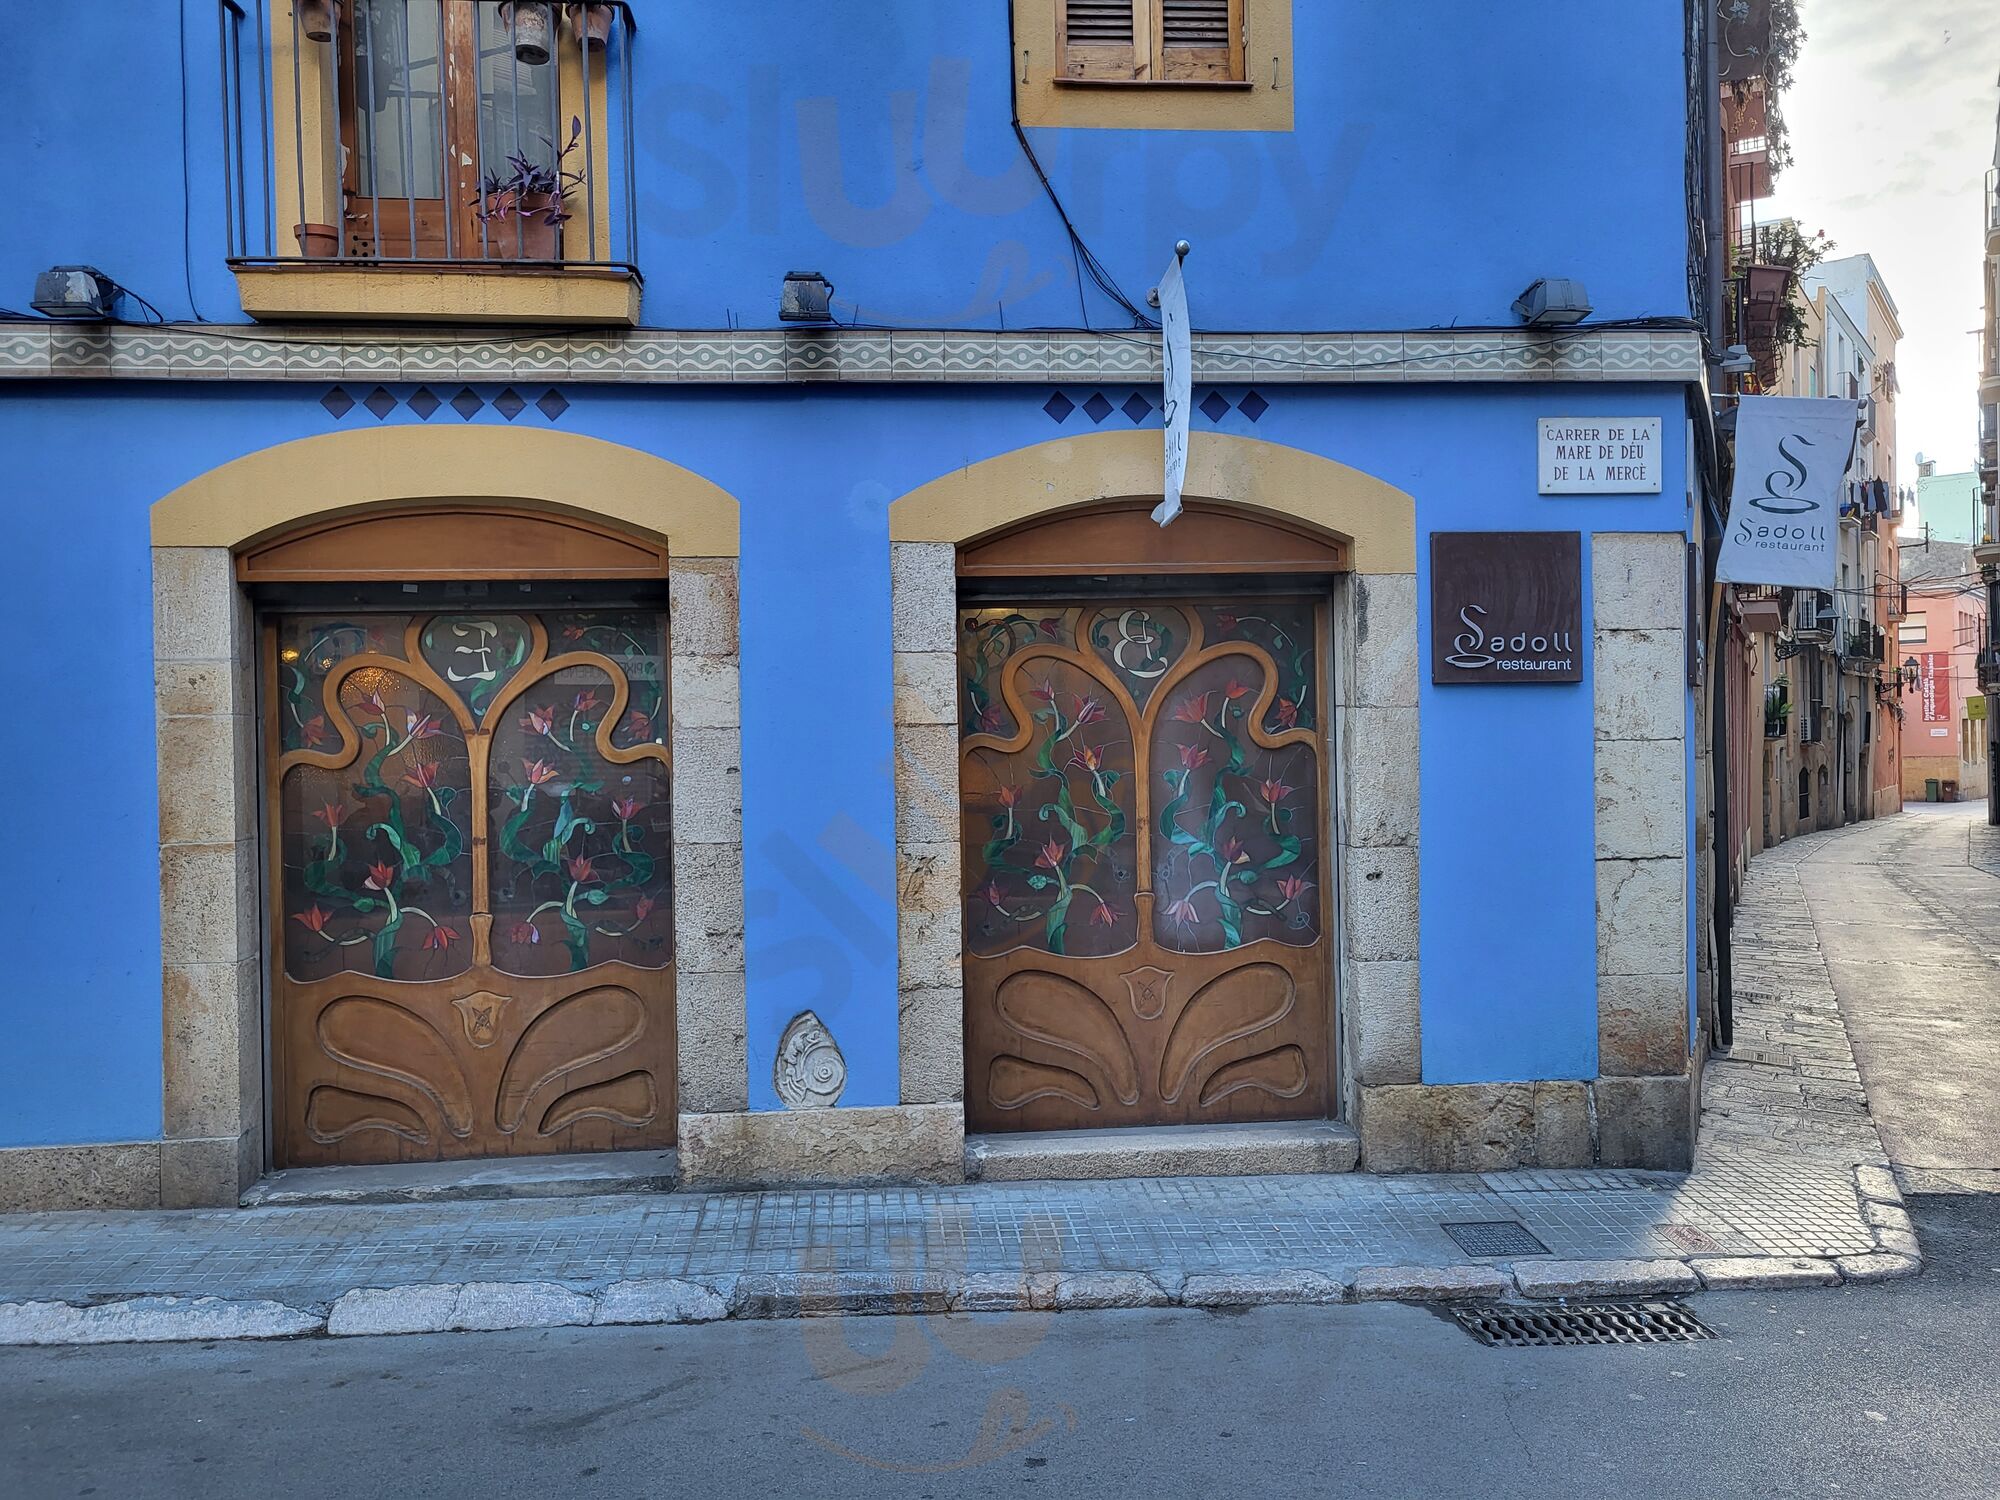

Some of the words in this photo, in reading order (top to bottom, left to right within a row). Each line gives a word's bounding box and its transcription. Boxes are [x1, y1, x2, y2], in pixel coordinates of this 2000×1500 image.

[1546, 428, 1600, 441] CARRER
[1608, 428, 1625, 441] DE
[1632, 428, 1651, 441] LA
[1555, 445, 1592, 460] MARE
[1599, 445, 1614, 459] DE
[1621, 441, 1644, 459] DÉU
[1554, 466, 1569, 481] DE
[1579, 466, 1595, 481] LA
[1605, 462, 1647, 481] MERCÈ
[1734, 517, 1826, 547] Sadoll
[1755, 540, 1825, 552] restaurant
[1453, 604, 1573, 656] Sadoll
[1496, 658, 1572, 670] restaurant
